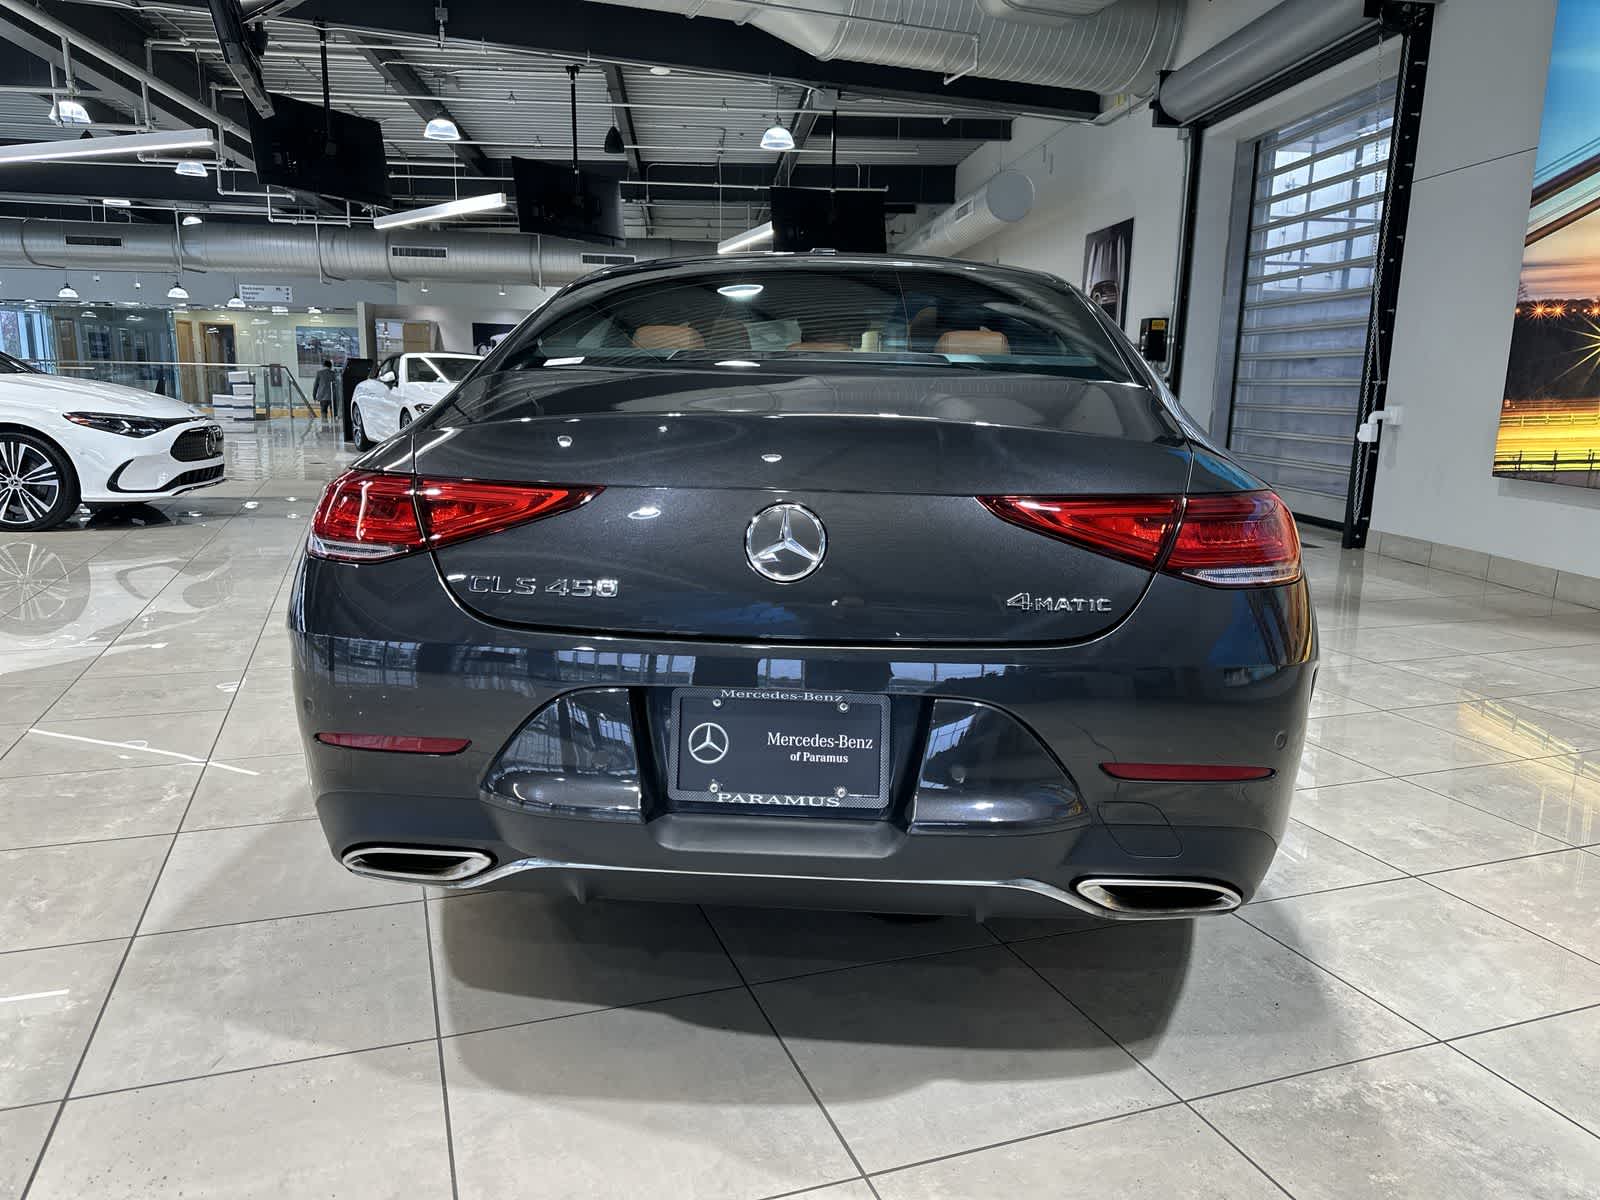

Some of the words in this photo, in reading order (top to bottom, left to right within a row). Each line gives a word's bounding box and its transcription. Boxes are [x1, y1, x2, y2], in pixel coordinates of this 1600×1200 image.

[468, 575, 537, 595] CLS
[545, 577, 619, 597] 450
[1006, 592, 1112, 612] 4MATIC
[720, 689, 844, 702] Mercedes-Benz
[767, 732, 873, 749] Mercedes-Benz
[790, 752, 800, 762] of
[803, 752, 849, 763] Paramus
[717, 793, 841, 807] PARAMUS
